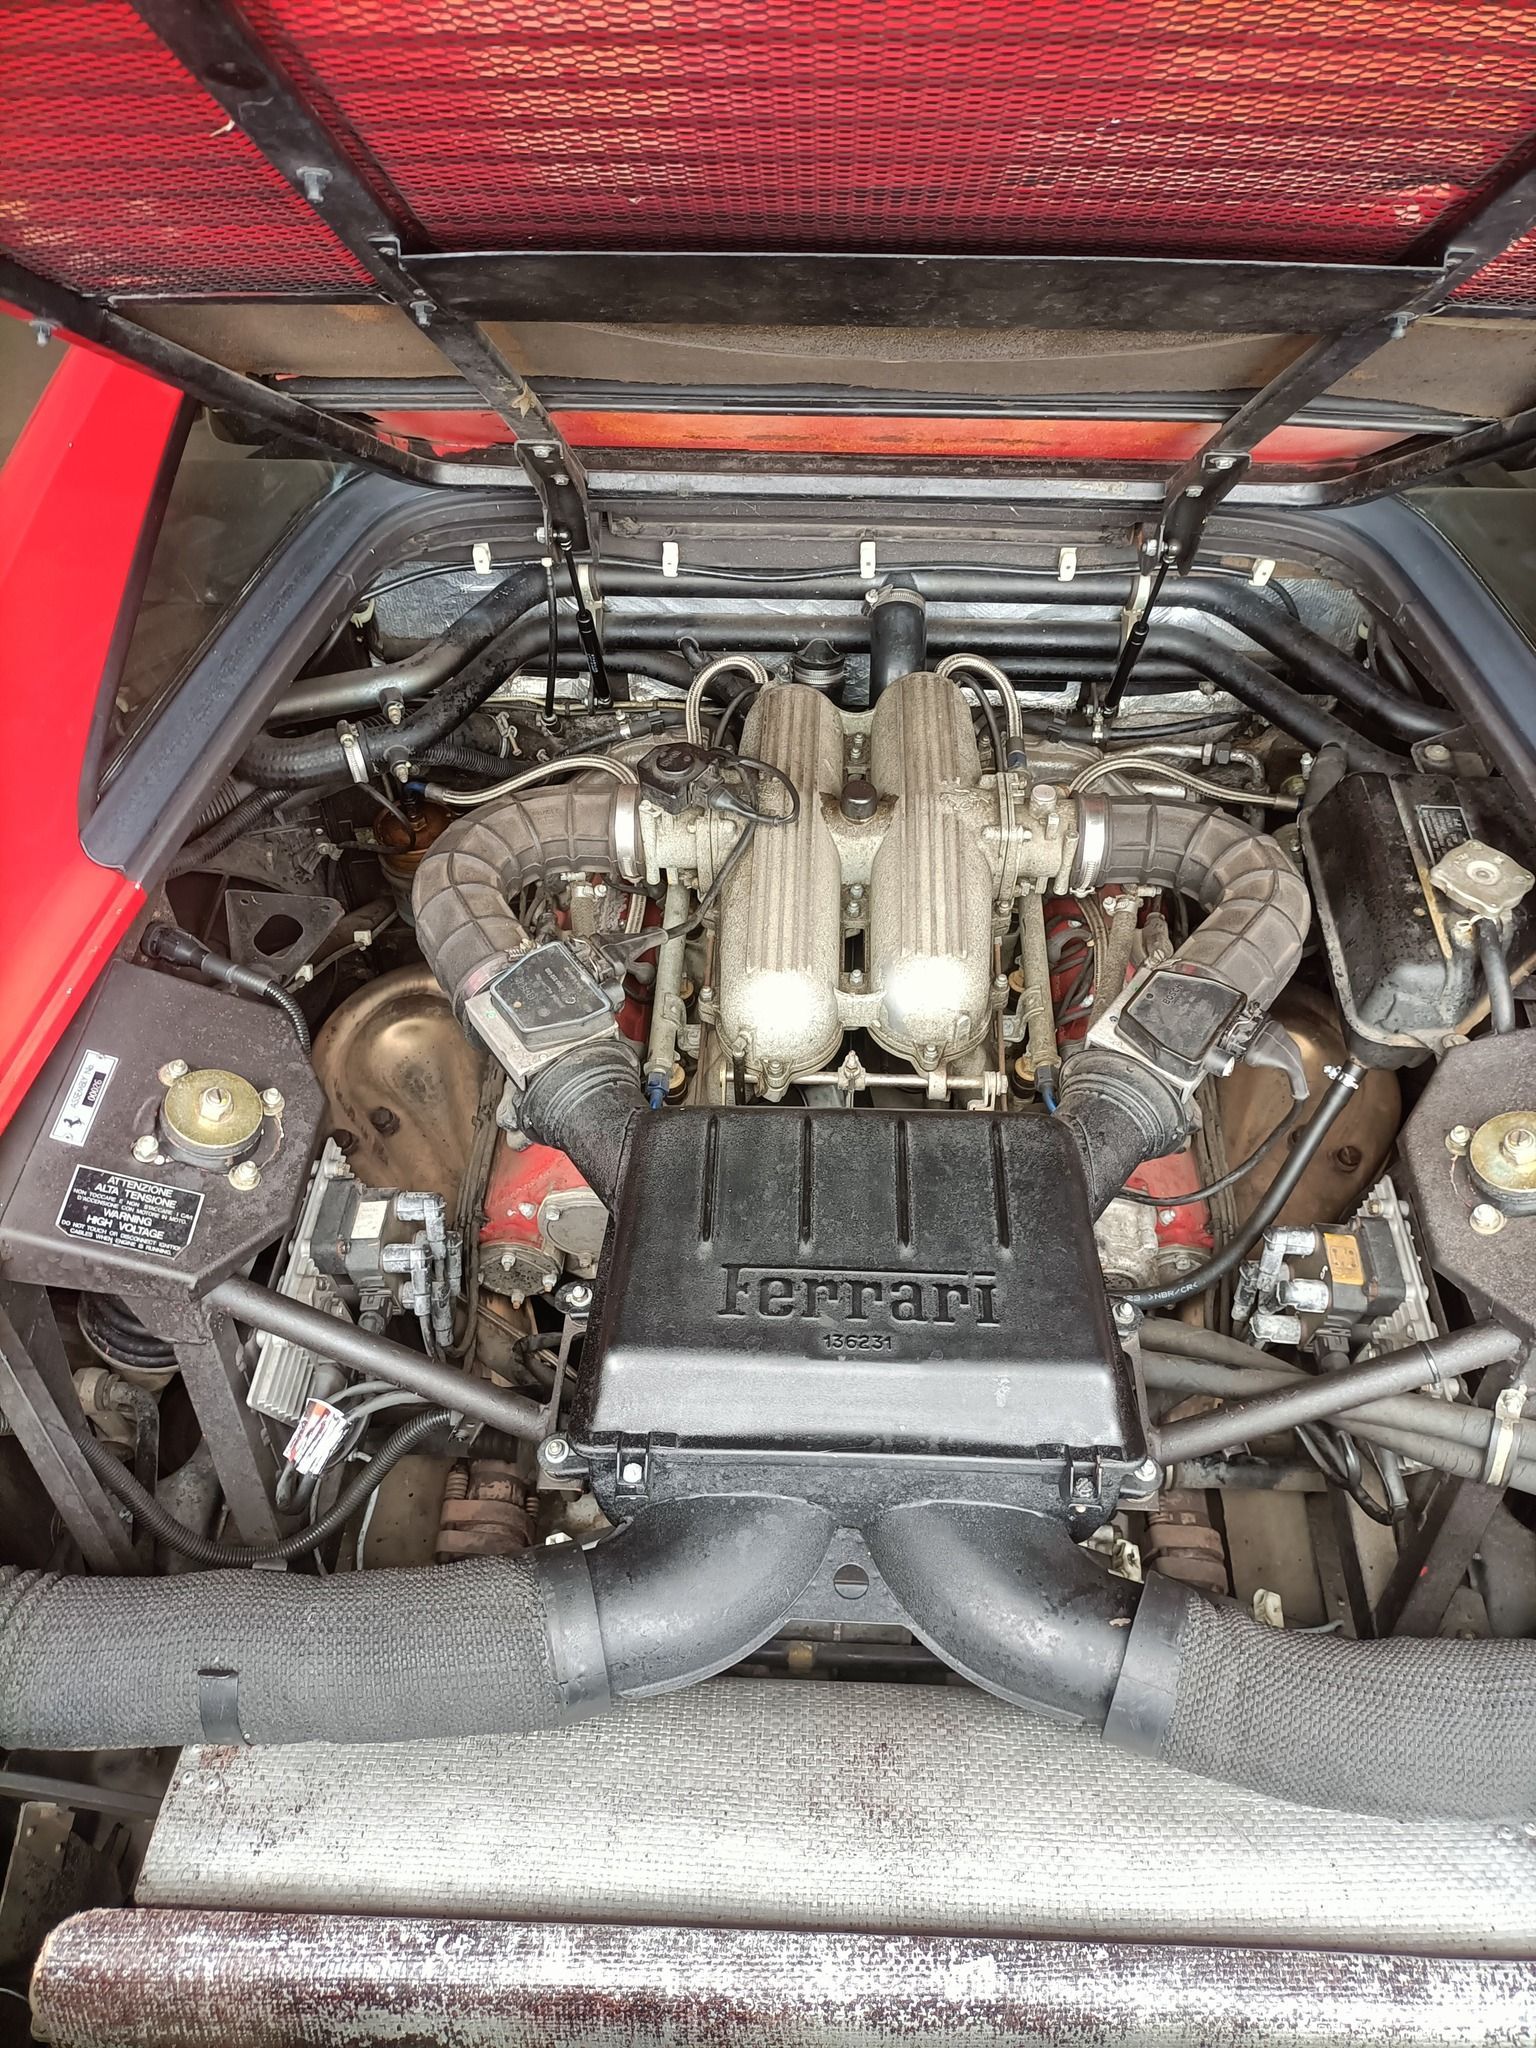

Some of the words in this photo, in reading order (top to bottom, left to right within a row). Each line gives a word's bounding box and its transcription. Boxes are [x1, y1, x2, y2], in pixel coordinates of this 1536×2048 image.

[1162, 984, 1183, 1005] BOSCH
[87, 1079, 102, 1102] 00026
[94, 1183, 119, 1196] ALTA
[125, 1189, 178, 1209] TENSIONE
[107, 1176, 174, 1198] ATTENZIONE
[73, 1188, 87, 1196] NON
[126, 1200, 141, 1208] NON
[103, 1208, 152, 1227] WARNING
[121, 1205, 135, 1213] CON
[72, 1222, 86, 1230] NOT
[87, 1225, 108, 1235] TOUCH
[86, 1214, 113, 1229] HIGH
[119, 1221, 165, 1240] VOLTAGE
[717, 1263, 1001, 1327] Ferrari
[823, 1333, 893, 1351] 136231
